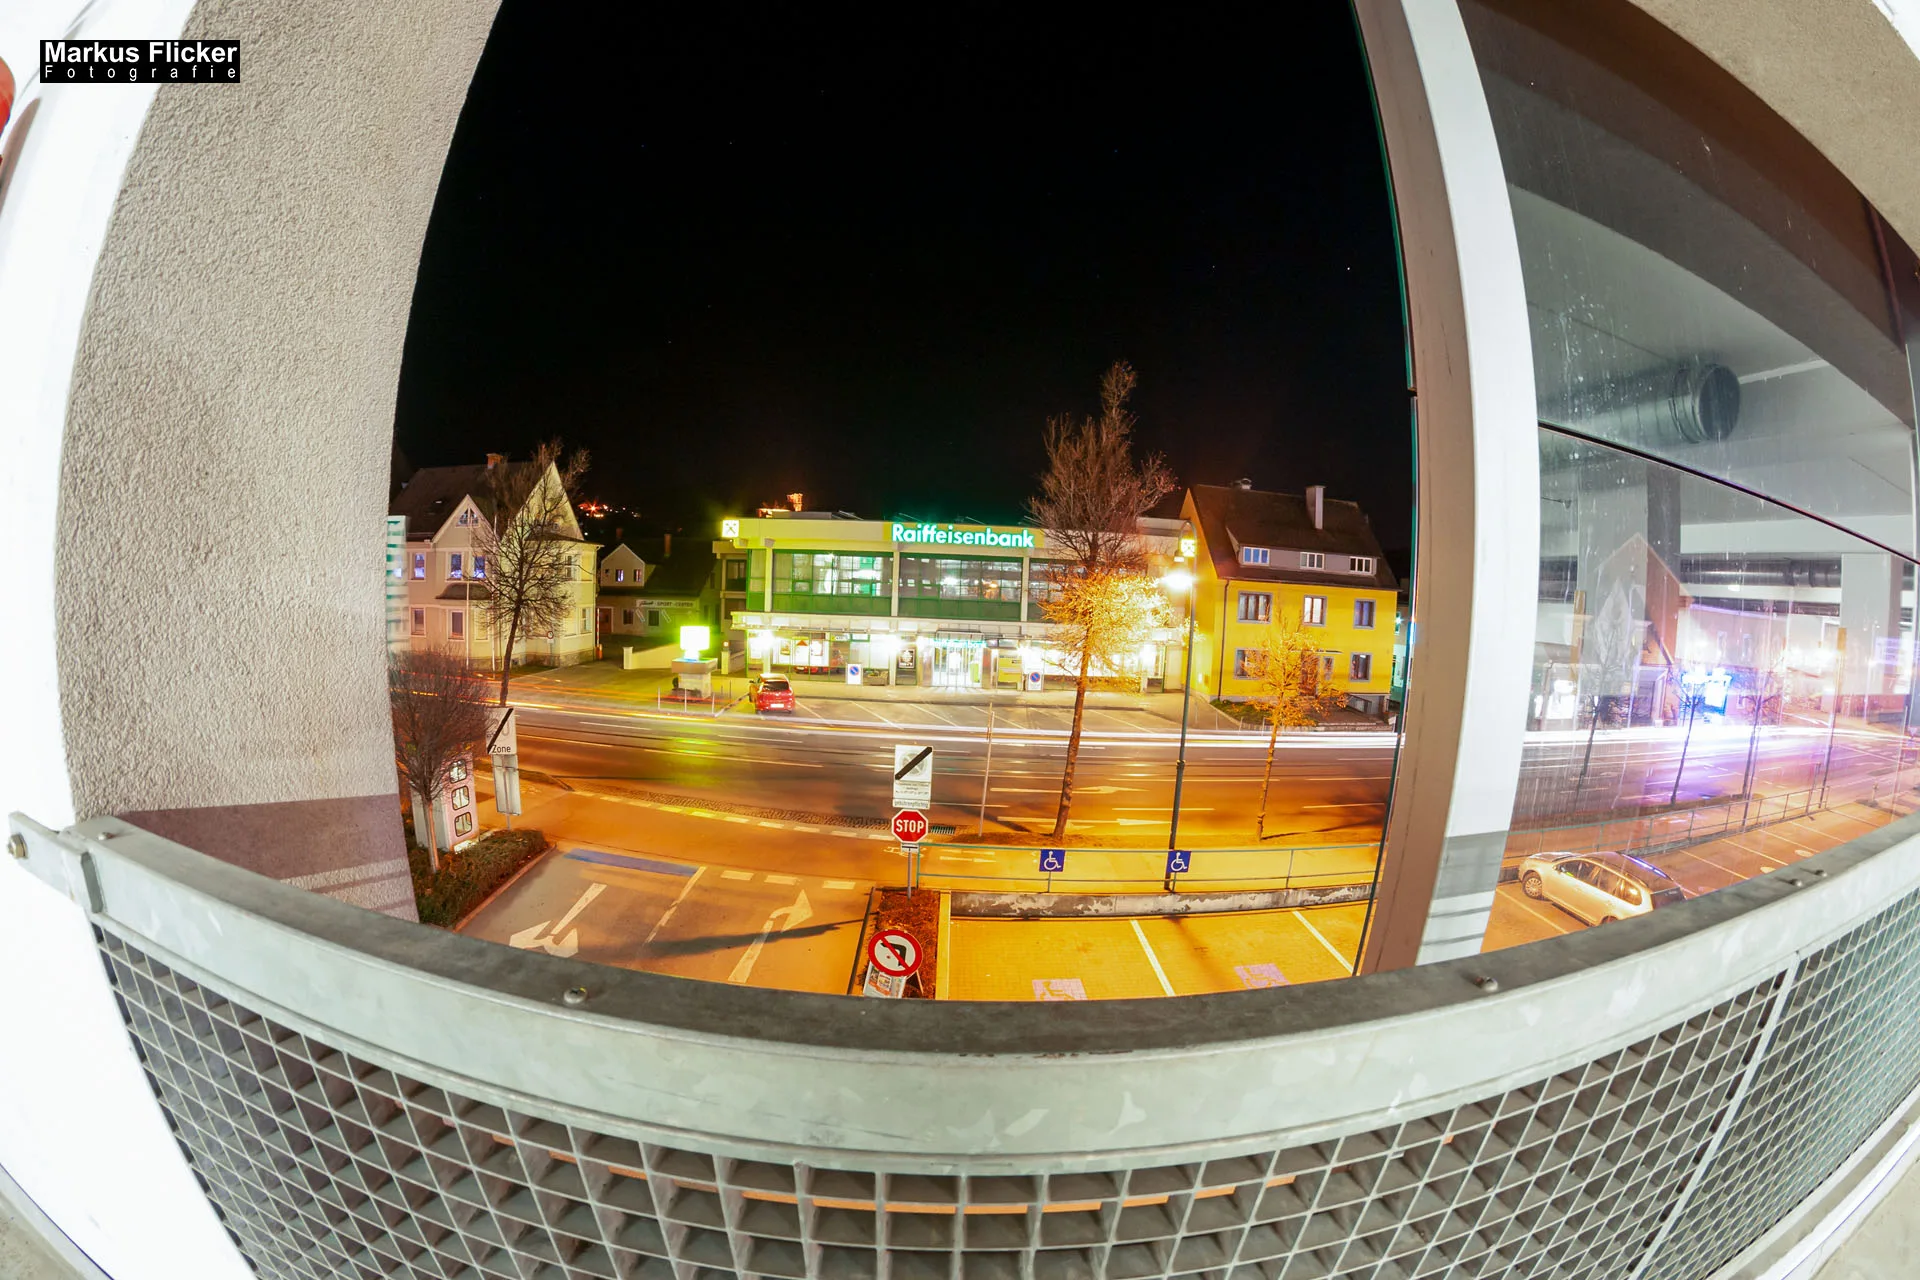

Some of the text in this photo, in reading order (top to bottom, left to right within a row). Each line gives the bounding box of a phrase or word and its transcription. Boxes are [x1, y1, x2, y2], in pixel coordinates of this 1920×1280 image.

[892, 523, 1034, 547] Raiffeisenbank
[492, 744, 511, 753] Zone
[896, 819, 924, 833] STOP
